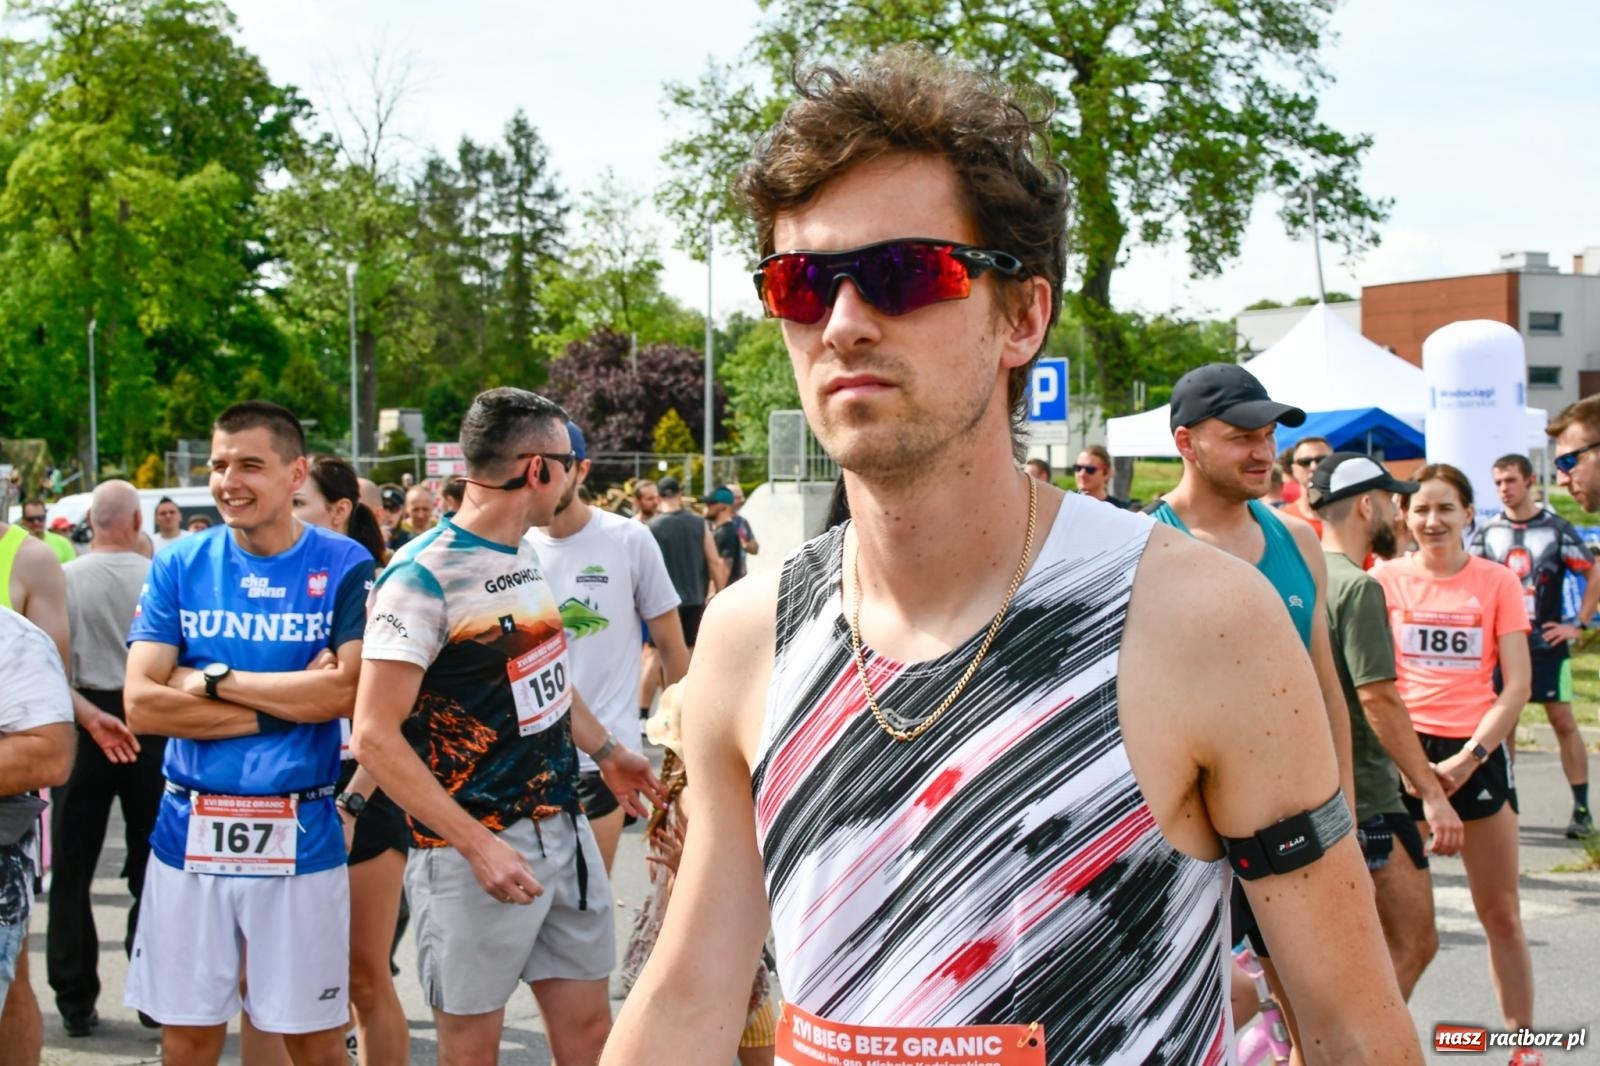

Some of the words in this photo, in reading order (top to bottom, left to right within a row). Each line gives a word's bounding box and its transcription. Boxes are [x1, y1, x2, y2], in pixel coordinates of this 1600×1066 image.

[1031, 366, 1058, 417] P
[1418, 629, 1468, 654] 186
[529, 662, 565, 708] 150
[212, 822, 274, 854] 167
[792, 1014, 812, 1041] XVI
[813, 1026, 851, 1052] BIEG
[855, 1035, 898, 1056] BEZ
[902, 1036, 1003, 1057] GRANIC
